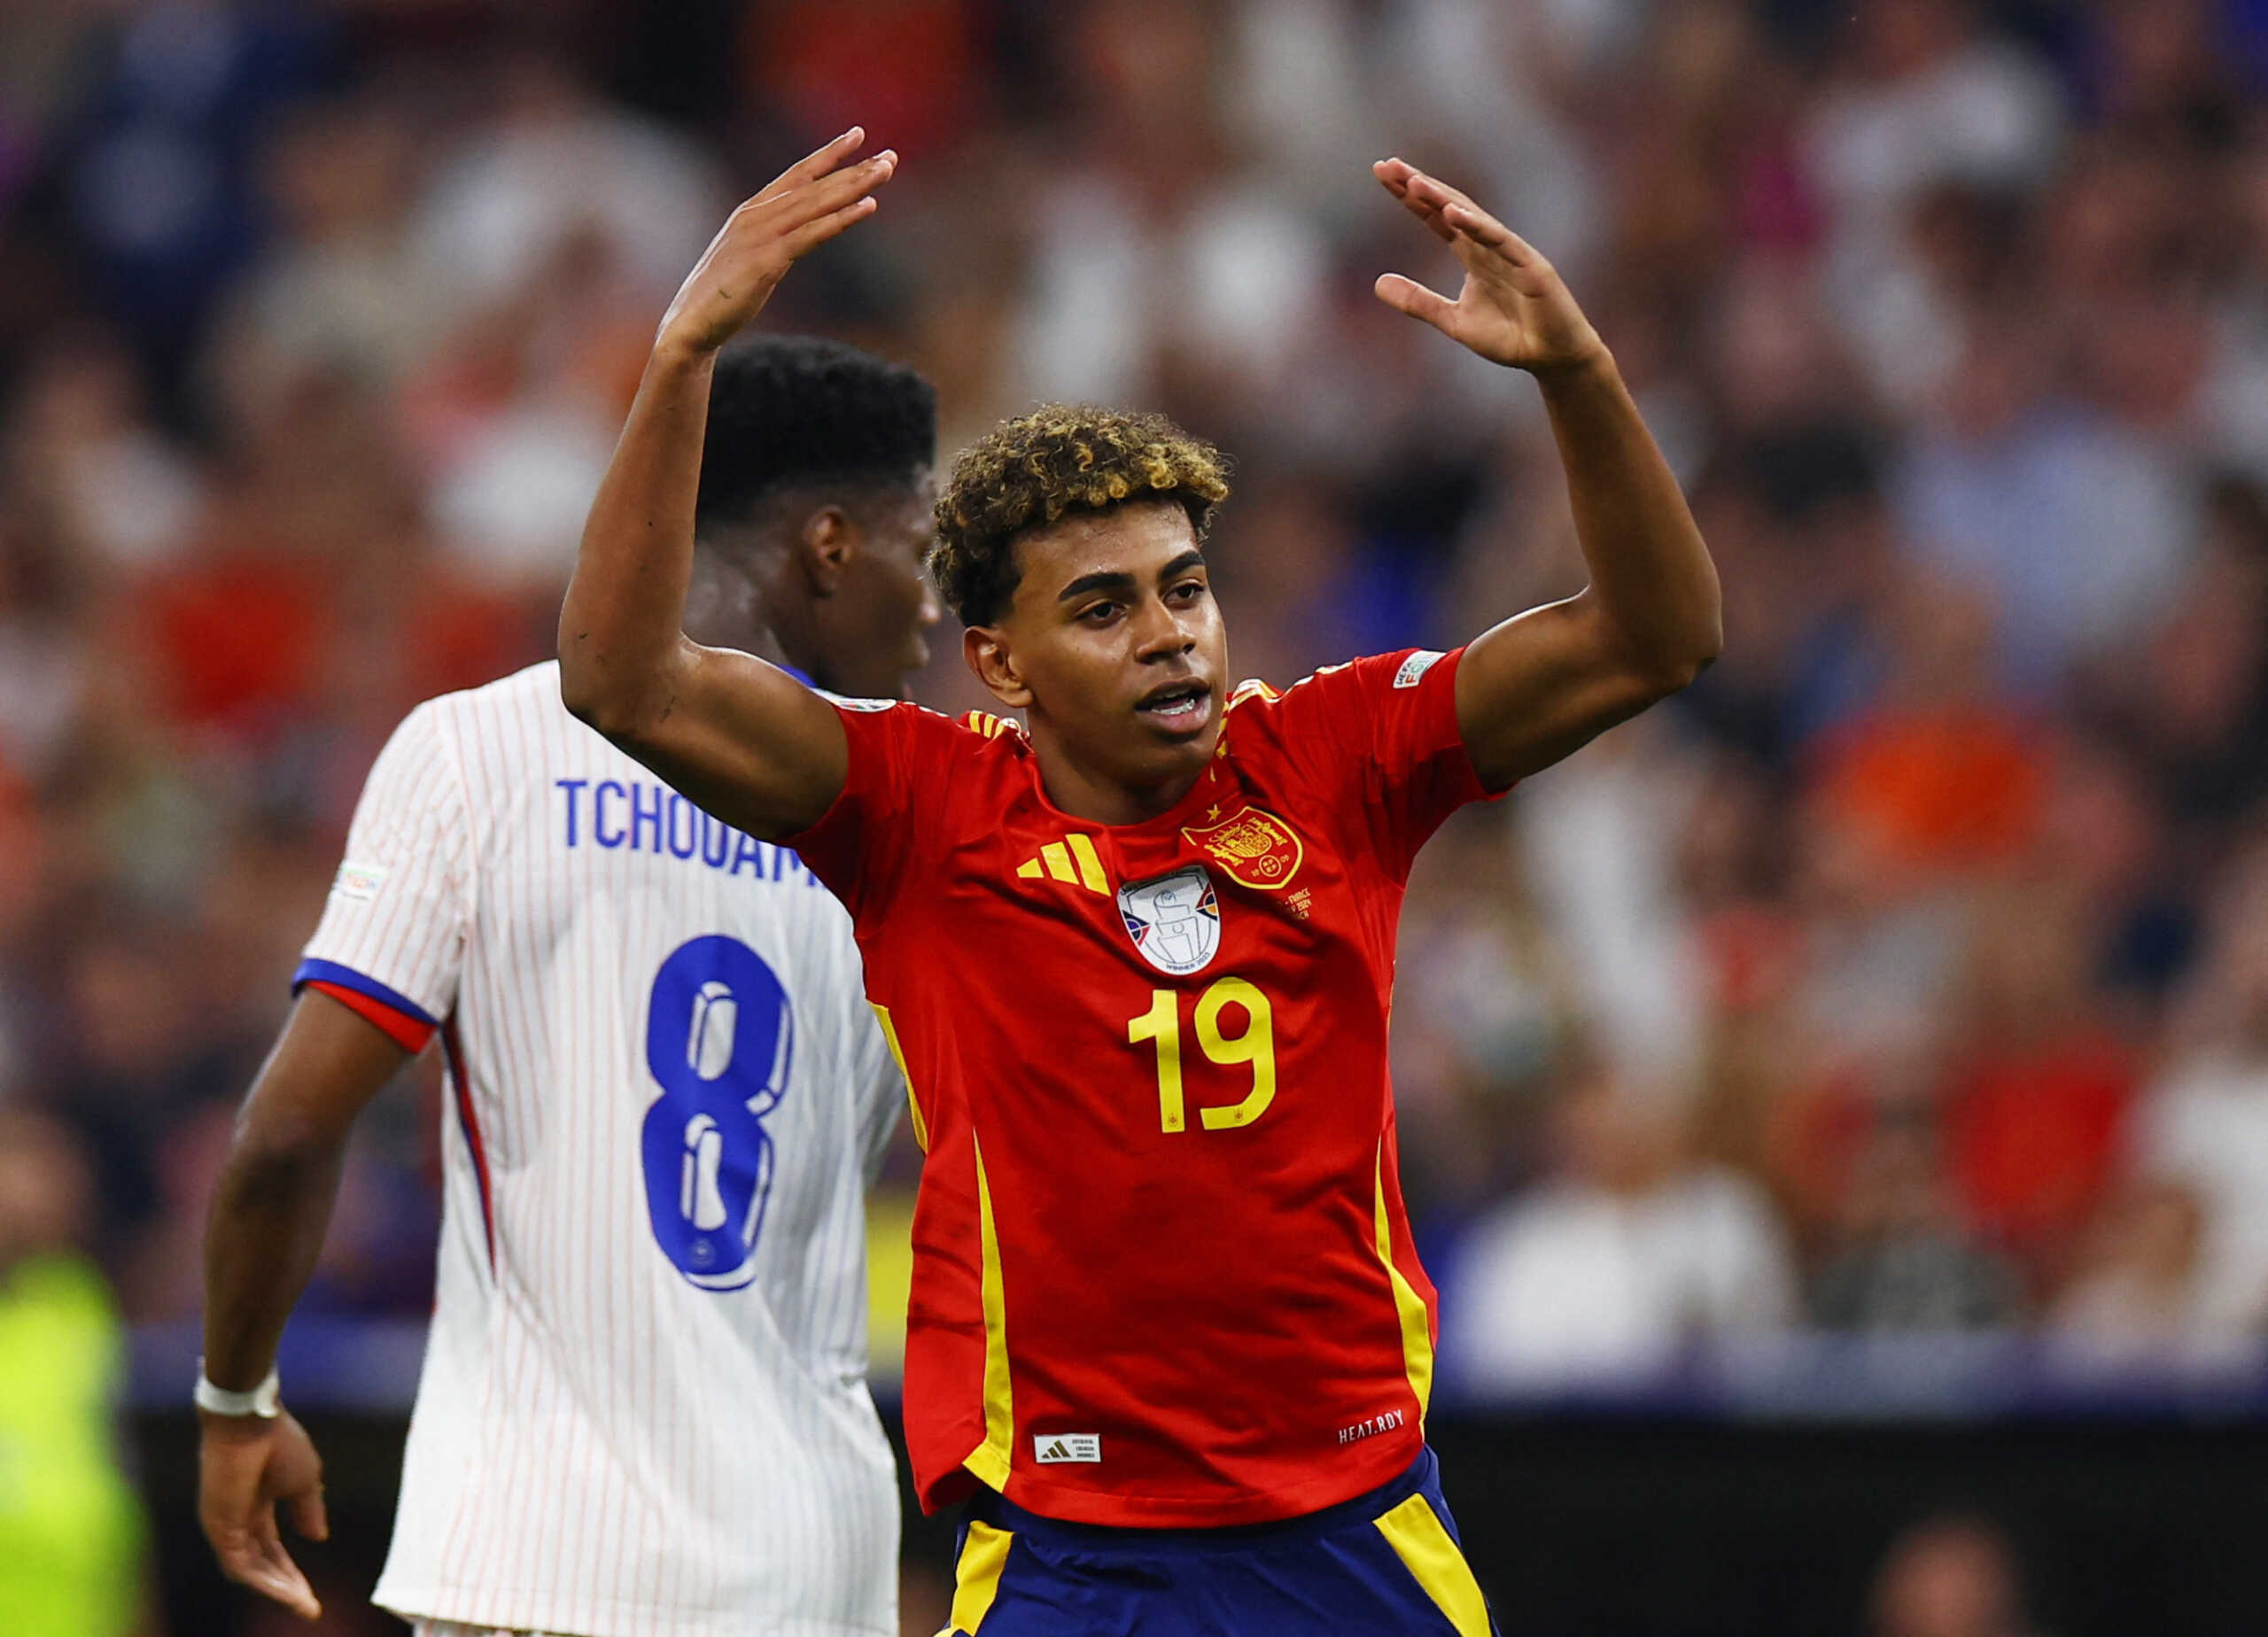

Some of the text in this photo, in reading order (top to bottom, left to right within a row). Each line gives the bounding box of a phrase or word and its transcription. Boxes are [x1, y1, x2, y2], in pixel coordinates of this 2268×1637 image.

[555, 780, 827, 890] TCHOUAM
[642, 935, 795, 1292] 8
[1128, 976, 1276, 1133] 19
[1339, 1408, 1404, 1444] HEAT.RDY
